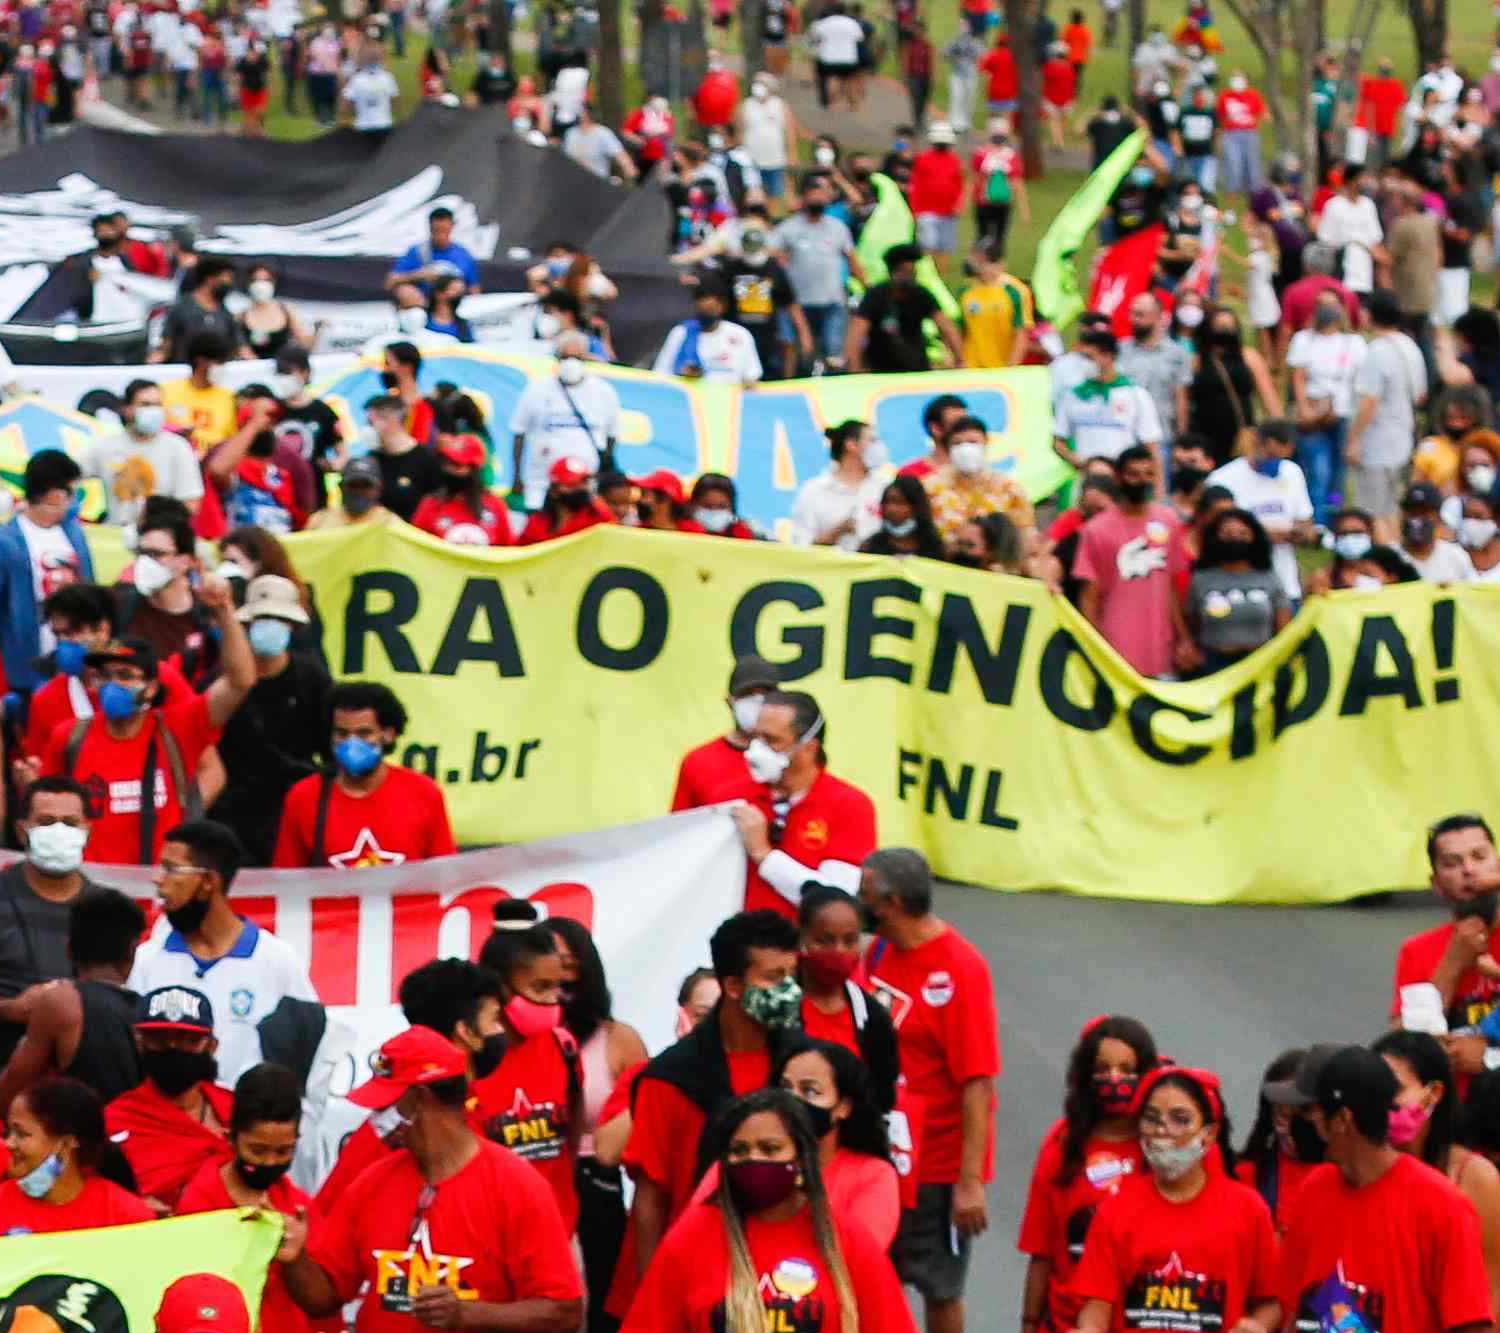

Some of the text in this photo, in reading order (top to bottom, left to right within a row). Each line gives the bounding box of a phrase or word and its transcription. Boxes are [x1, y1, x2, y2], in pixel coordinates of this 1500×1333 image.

[577, 566, 671, 671] O
[729, 577, 1461, 766] GENOCIDA!
[899, 747, 1020, 830] FNL
[503, 1118, 557, 1146] FNL
[1144, 1284, 1200, 1311] FNL
